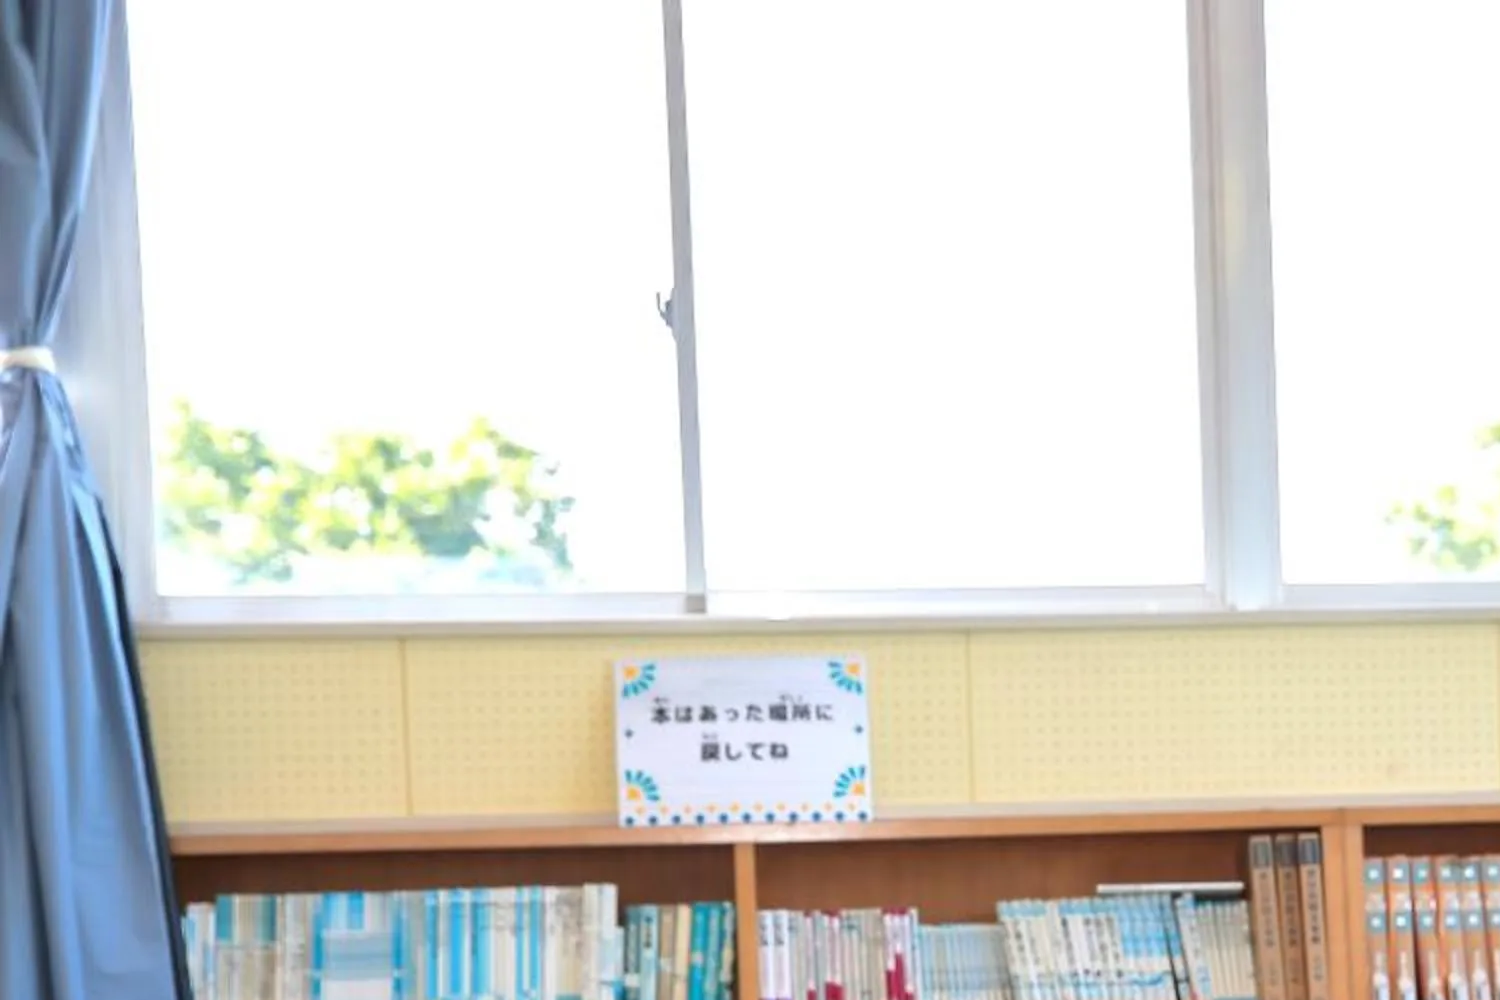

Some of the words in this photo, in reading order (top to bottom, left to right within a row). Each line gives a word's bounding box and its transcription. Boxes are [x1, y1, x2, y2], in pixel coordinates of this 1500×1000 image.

[651, 703, 834, 724] 本はあった場所に
[701, 742, 789, 761] 戻してね
